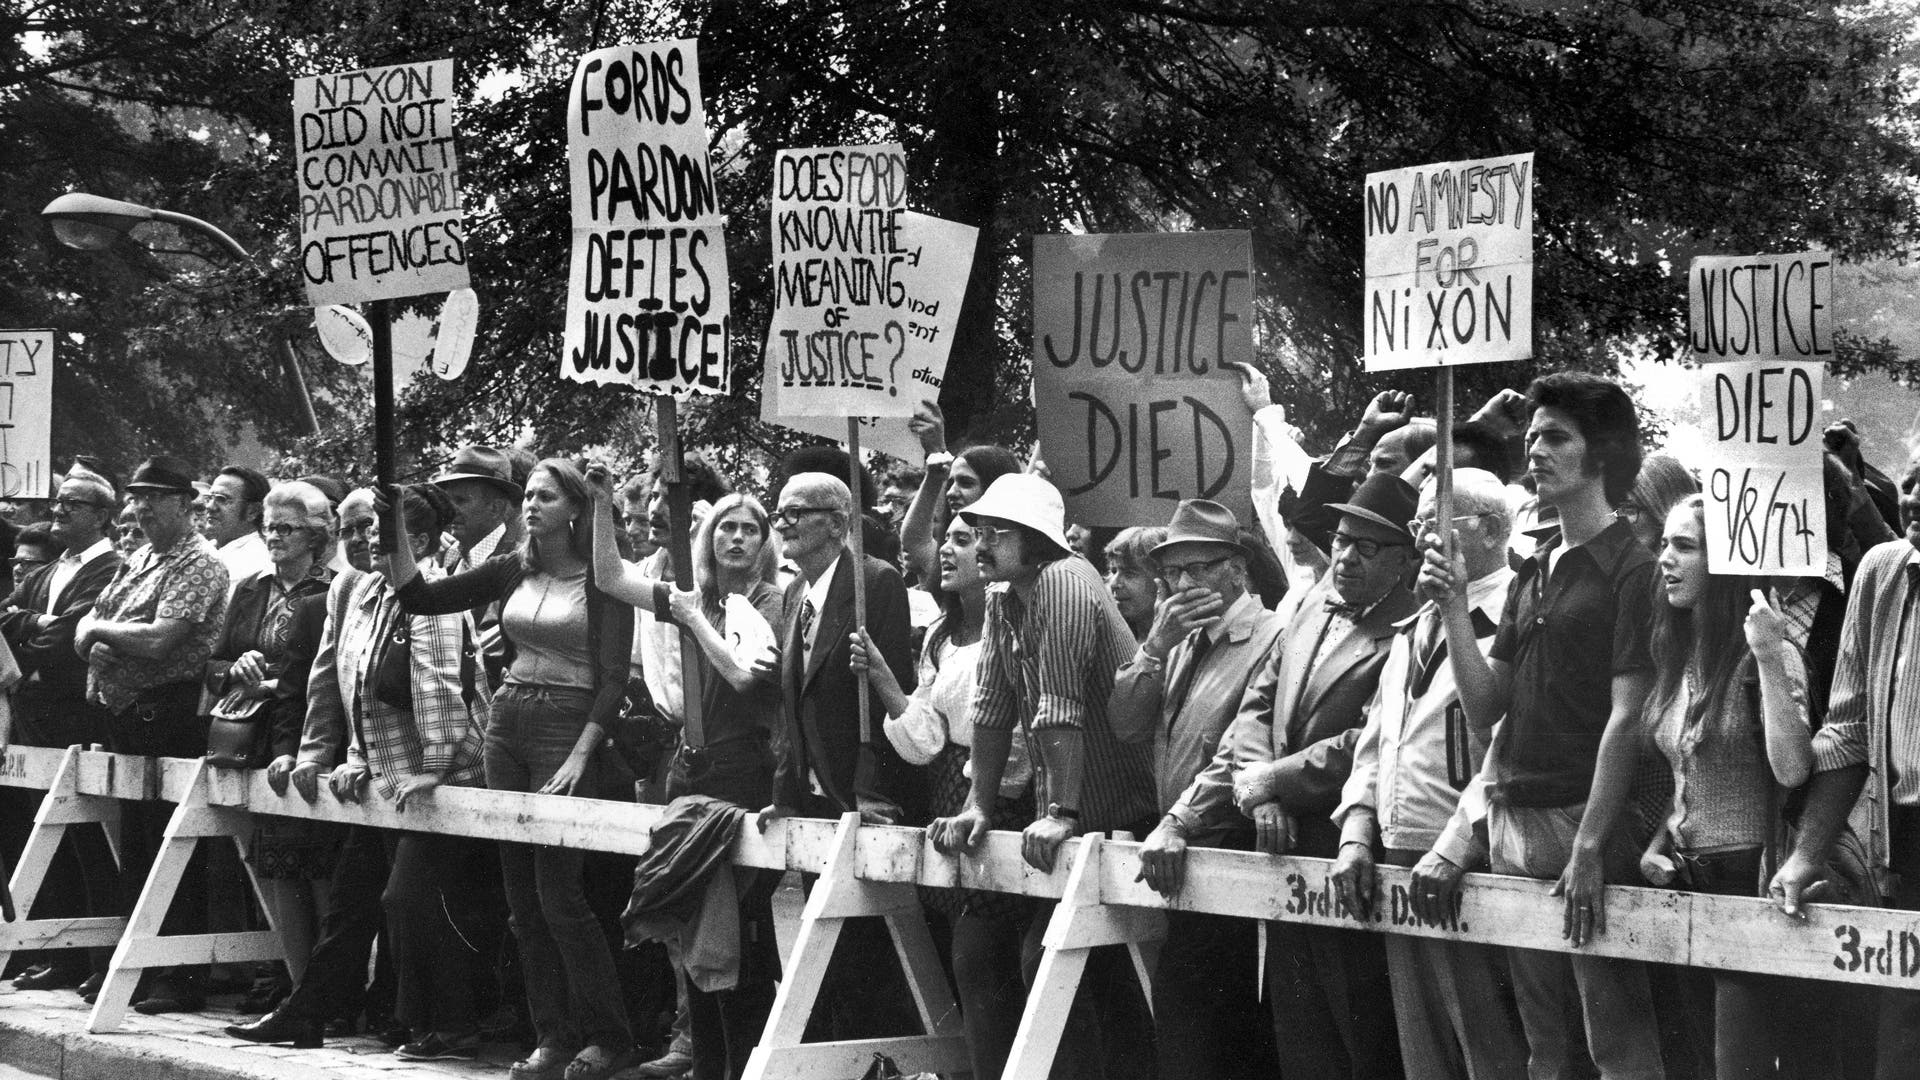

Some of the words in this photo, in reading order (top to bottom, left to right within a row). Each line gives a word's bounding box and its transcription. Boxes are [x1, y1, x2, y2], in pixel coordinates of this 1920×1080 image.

[314, 65, 433, 109] NIXON
[580, 47, 692, 137] FORDS
[300, 106, 368, 154] DID
[380, 98, 446, 145] NOT
[302, 136, 454, 191] COMMIT
[587, 142, 716, 222] PARDON
[779, 151, 846, 202] DOES
[848, 152, 908, 208] FORD
[301, 171, 463, 235] PARDONABLE
[778, 206, 863, 254] KNOW
[863, 207, 909, 255] THE
[1367, 181, 1400, 237] NO
[1408, 160, 1529, 234] AMNESTY
[302, 218, 467, 285] OFFENCES
[584, 228, 711, 318] DEFIES
[776, 255, 906, 310] MEANING
[1414, 236, 1481, 289] FOR
[823, 306, 850, 328] OF
[1043, 270, 1251, 376] JUSTICE
[1693, 259, 1832, 357] JUSTICE
[571, 310, 731, 393] JUSTICE!
[778, 319, 906, 398] JUSTICE?
[1715, 367, 1814, 447] DIED
[1068, 391, 1236, 500] DIED
[1711, 467, 1816, 570] 9/8/74
[1285, 873, 1330, 918] 3rd
[1833, 924, 1893, 976] 3rd
